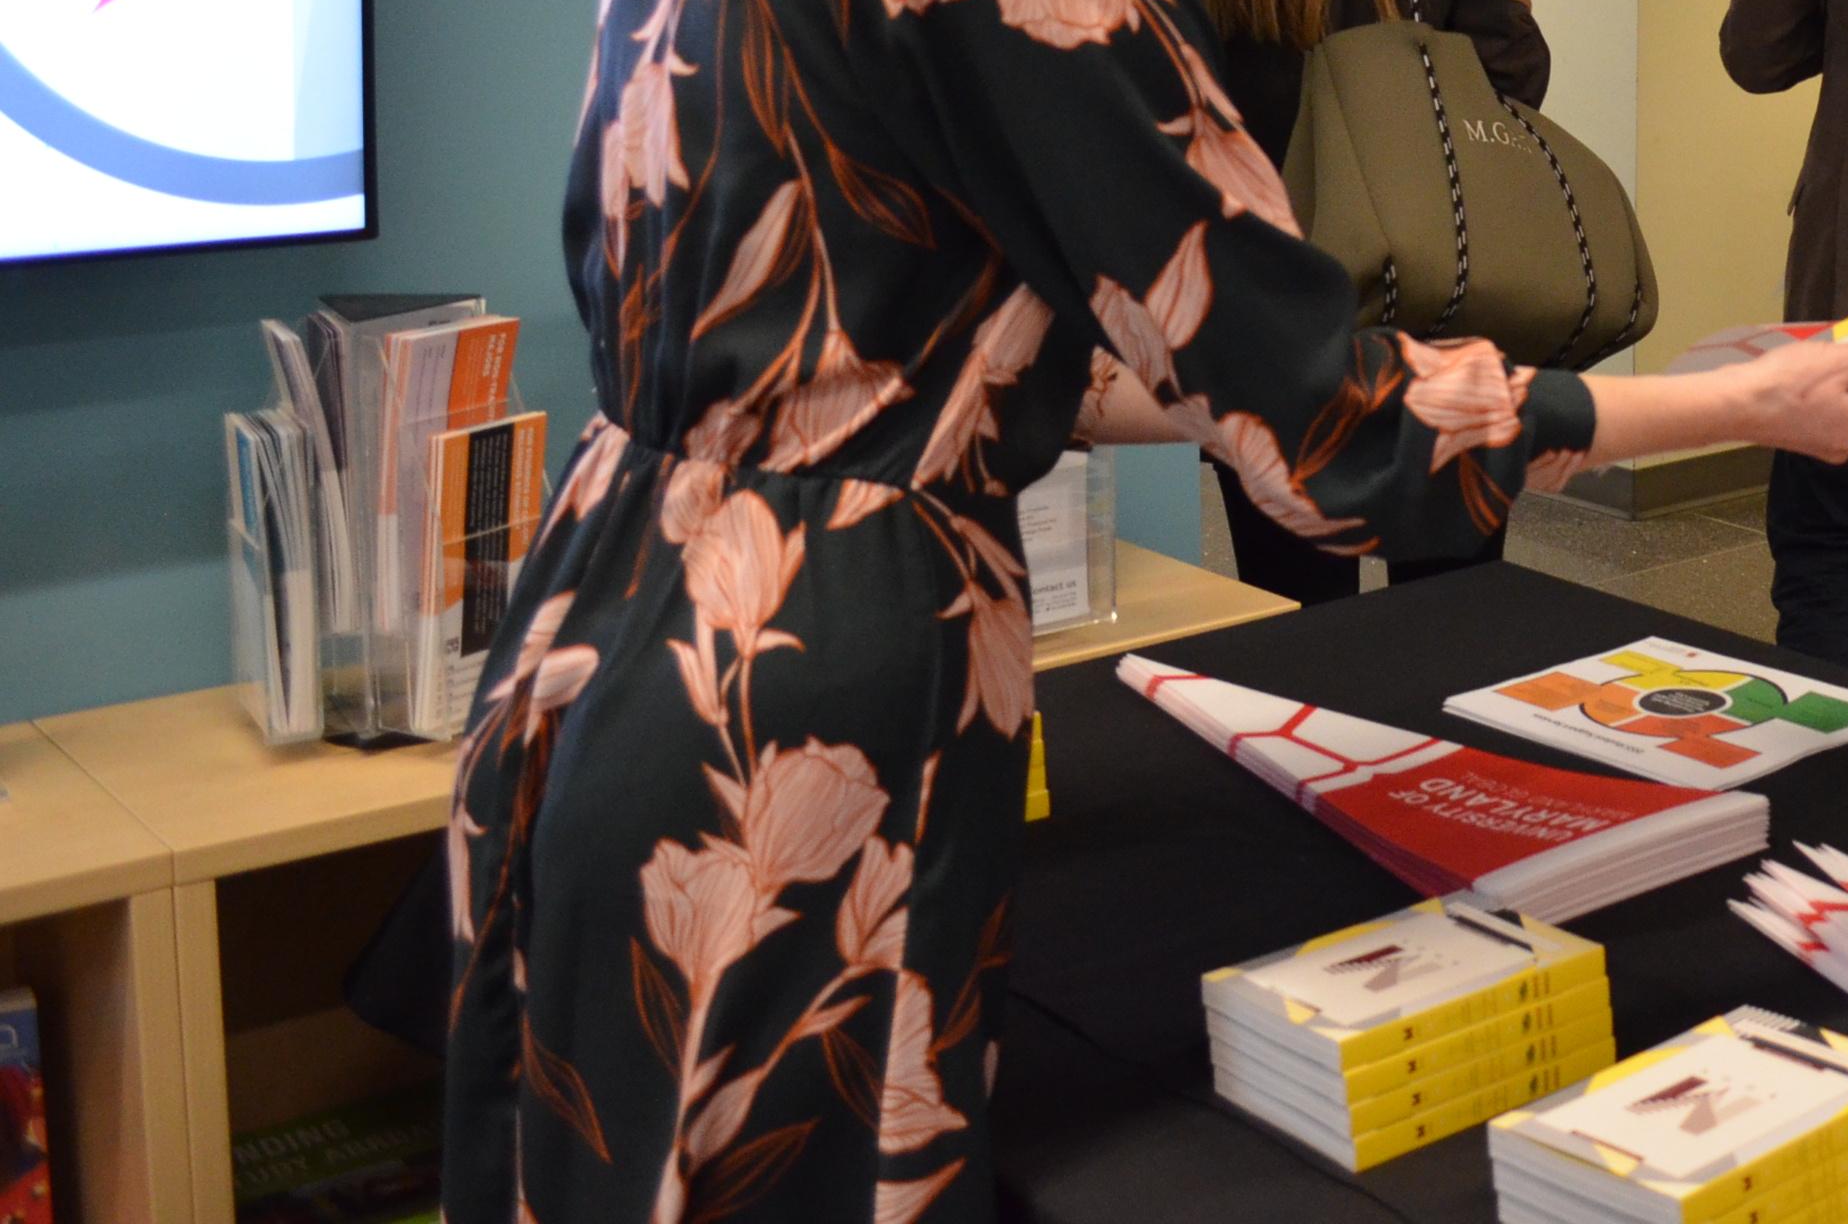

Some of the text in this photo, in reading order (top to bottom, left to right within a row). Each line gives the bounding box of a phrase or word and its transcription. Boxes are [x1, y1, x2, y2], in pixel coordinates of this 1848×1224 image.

[1388, 790, 1574, 842] UNIVERSITY OF
[1419, 777, 1612, 832] MARYLAND
